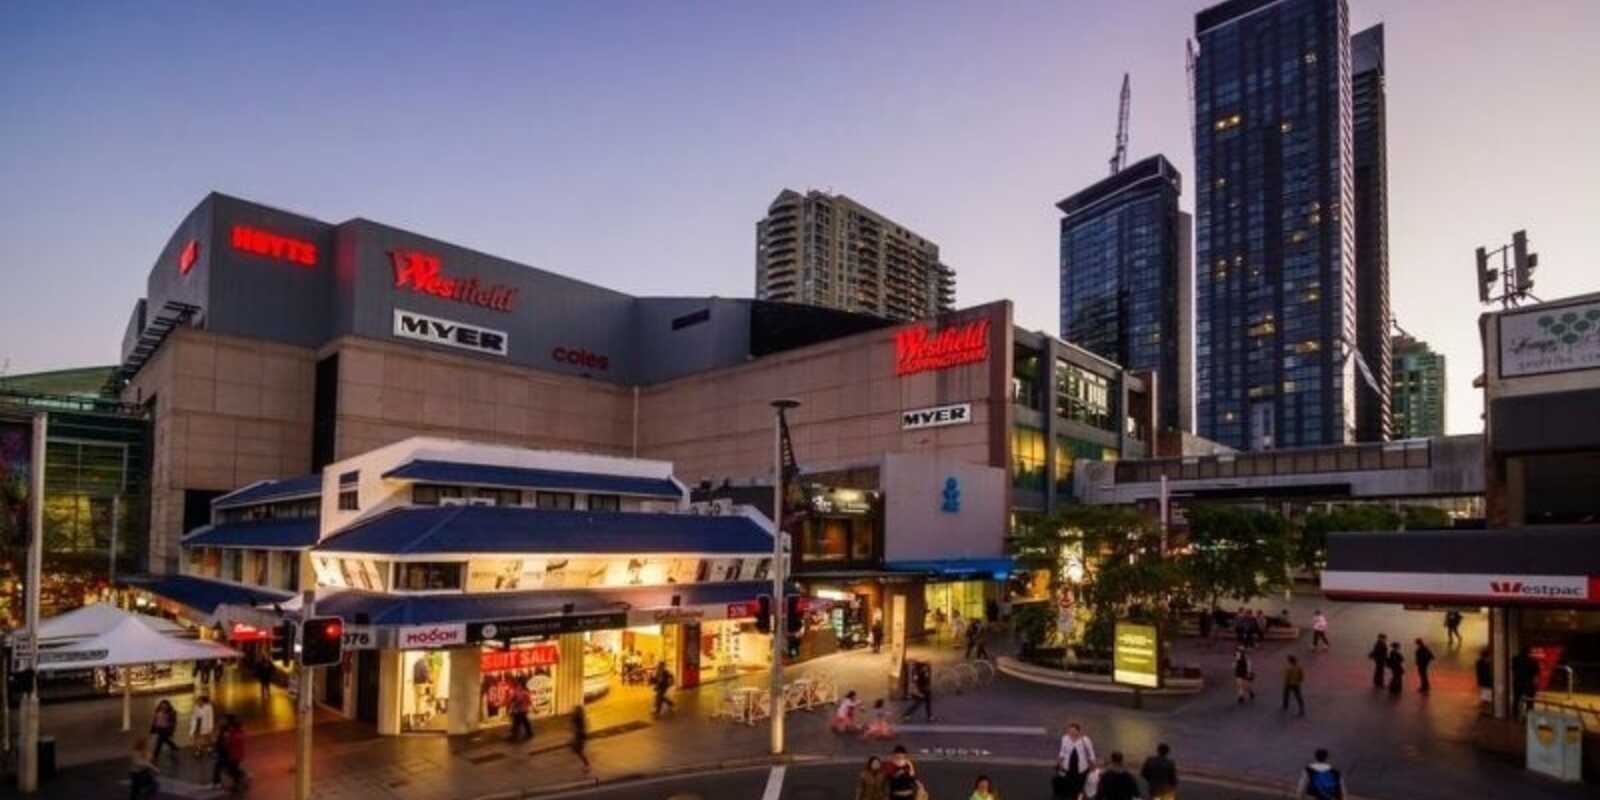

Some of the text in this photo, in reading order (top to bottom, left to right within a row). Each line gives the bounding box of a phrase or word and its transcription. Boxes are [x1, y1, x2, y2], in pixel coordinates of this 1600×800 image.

[387, 248, 519, 312] Westfield
[401, 315, 504, 351] MYER
[895, 318, 990, 362] Westfield
[551, 345, 609, 372] coles
[904, 407, 966, 426] MYER
[1490, 581, 1584, 596] Westpac
